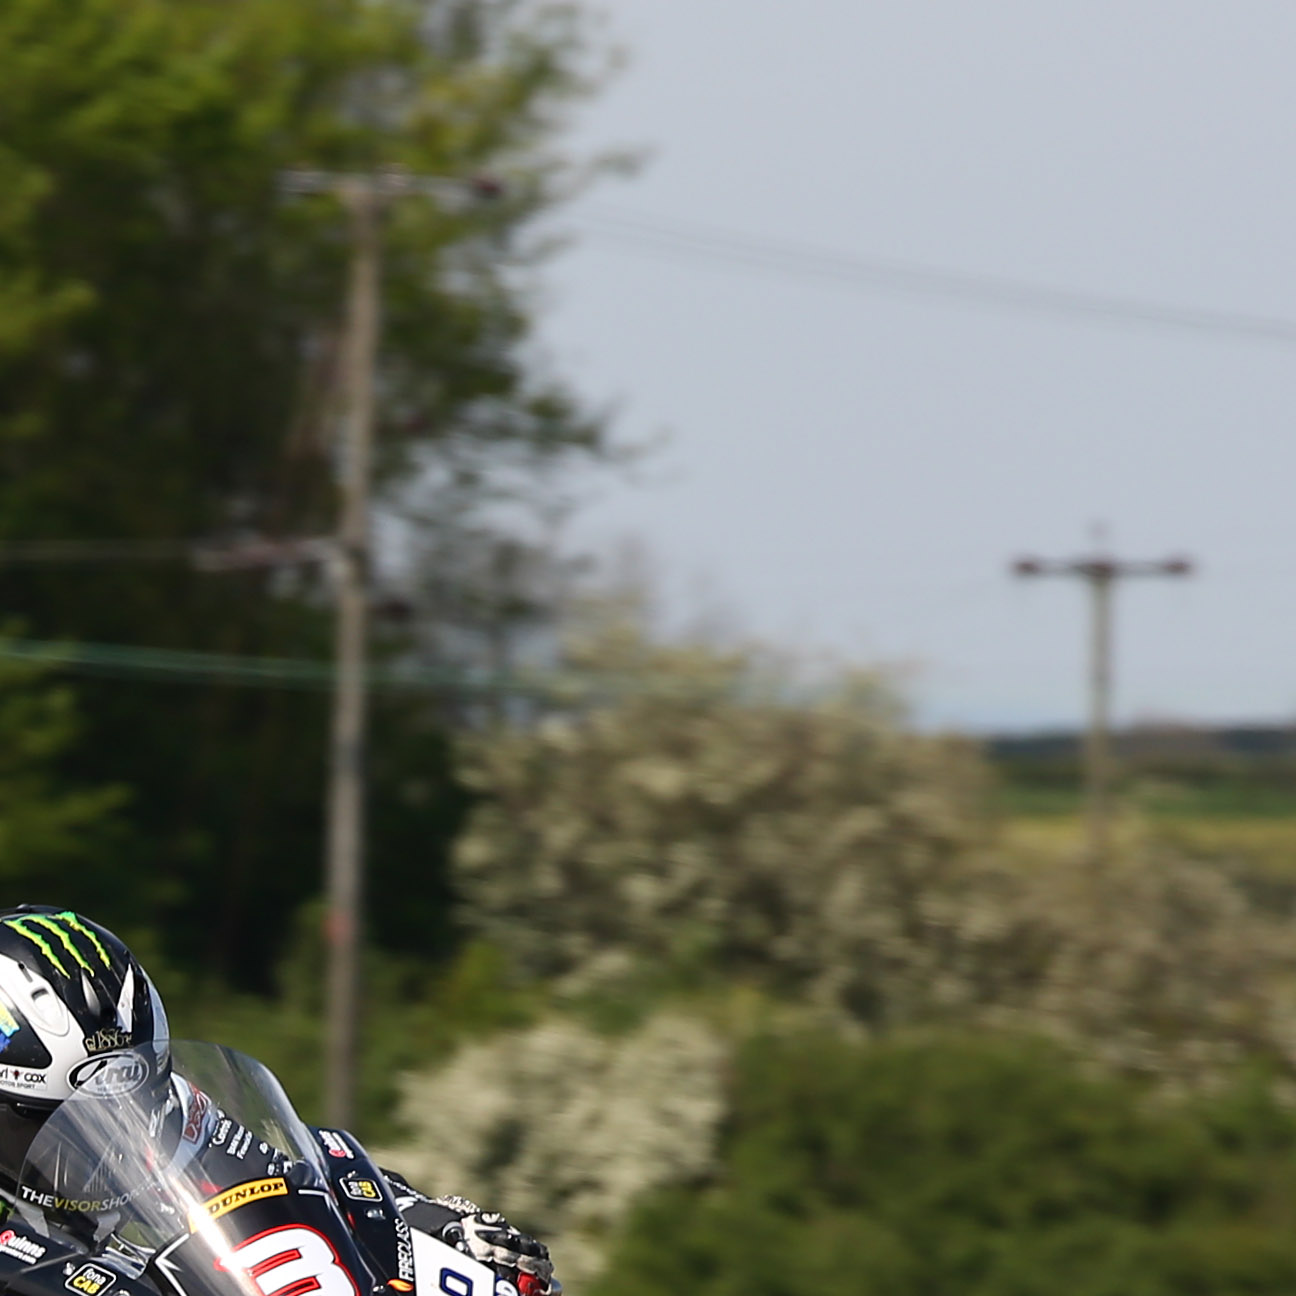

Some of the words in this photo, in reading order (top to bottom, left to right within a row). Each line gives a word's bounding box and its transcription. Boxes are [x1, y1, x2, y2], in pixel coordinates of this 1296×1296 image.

[24, 1072, 47, 1084] cox
[208, 1180, 285, 1216] DUNLOP
[394, 1218, 414, 1281] FIRECLASS
[73, 1275, 101, 1295] CAB
[82, 1268, 107, 1285] fona
